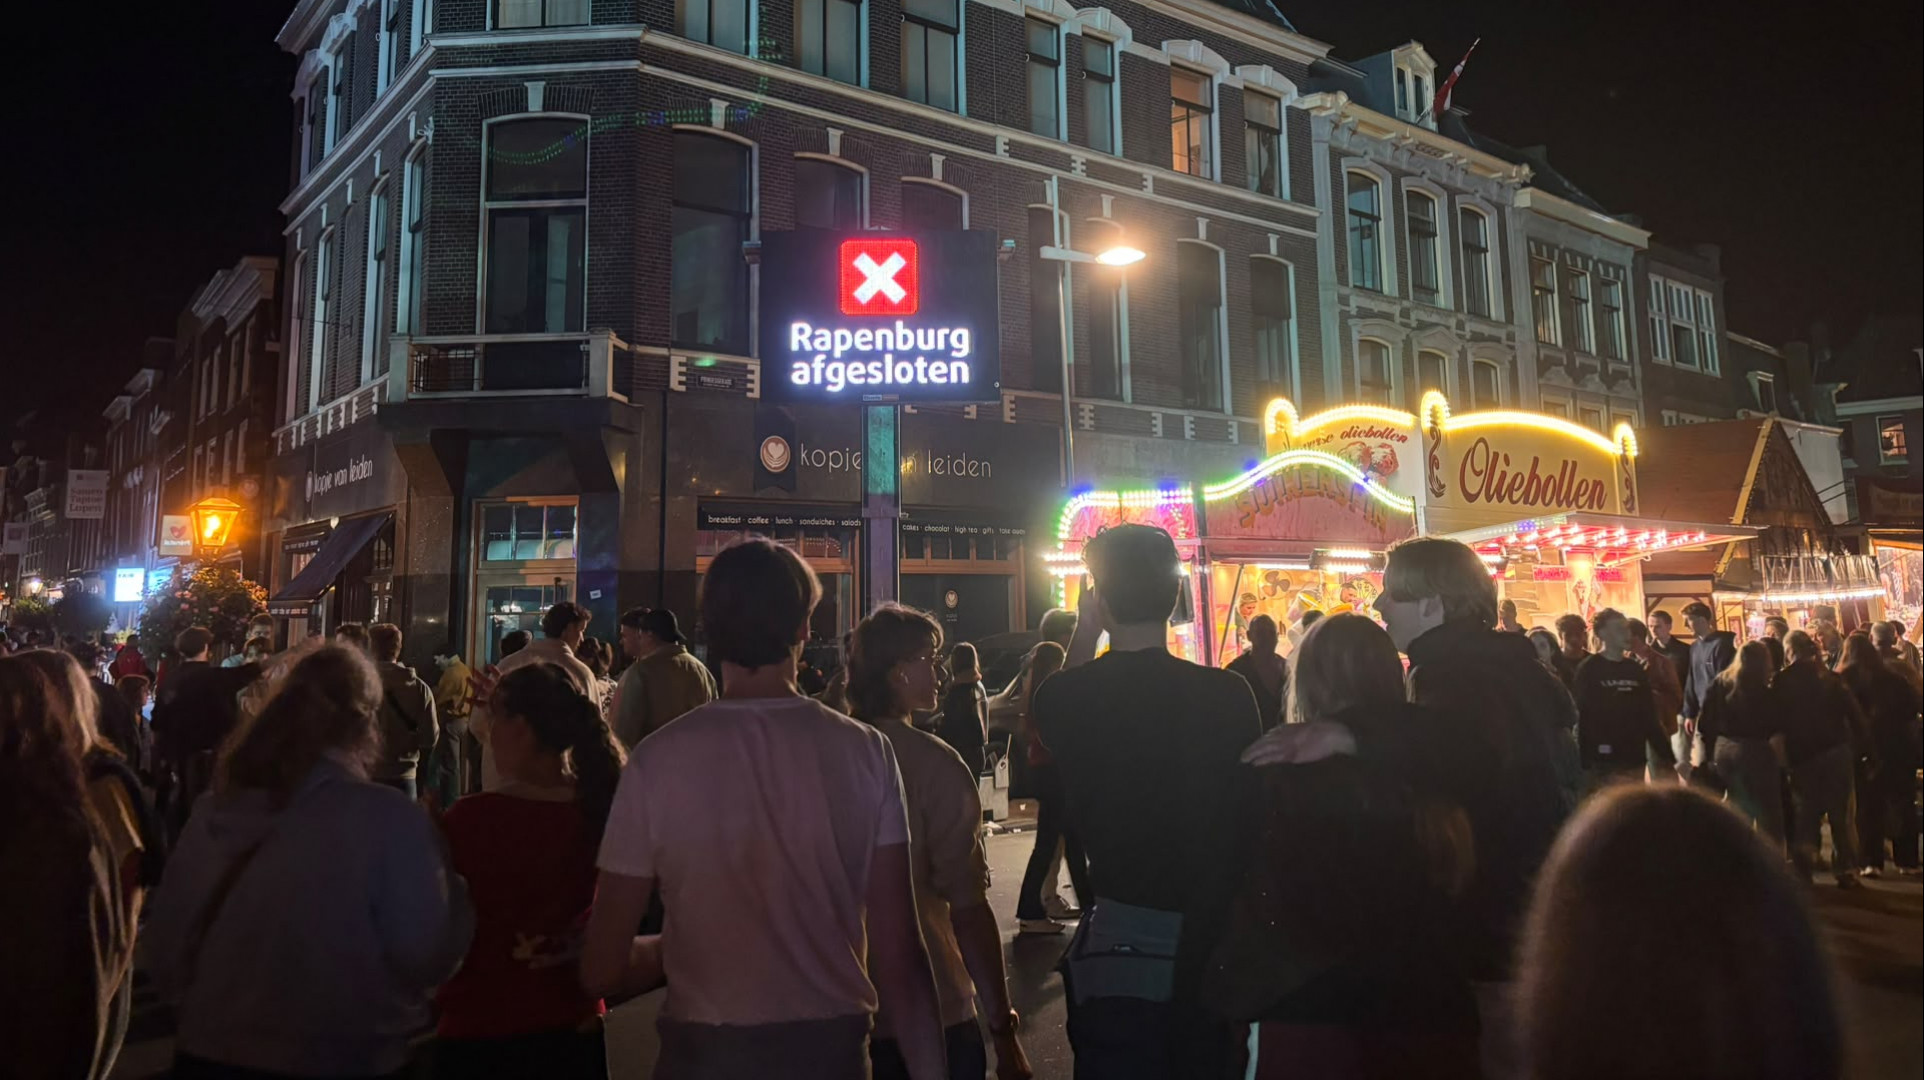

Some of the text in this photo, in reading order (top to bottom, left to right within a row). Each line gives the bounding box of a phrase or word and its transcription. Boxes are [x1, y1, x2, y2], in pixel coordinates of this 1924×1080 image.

[790, 320, 970, 358] Rapenburg
[790, 353, 970, 392] afgesloten
[1340, 425, 1408, 443] oliebollen
[314, 454, 373, 496] kopje van leiden
[800, 442, 862, 473] kopje
[928, 449, 991, 478] leiden
[1459, 436, 1608, 511] Oliebollen
[707, 515, 862, 527] breakfast coffee lunch sandwiches salads
[902, 523, 920, 532] cakes
[924, 524, 950, 533] chocolat
[955, 525, 967, 534] high
